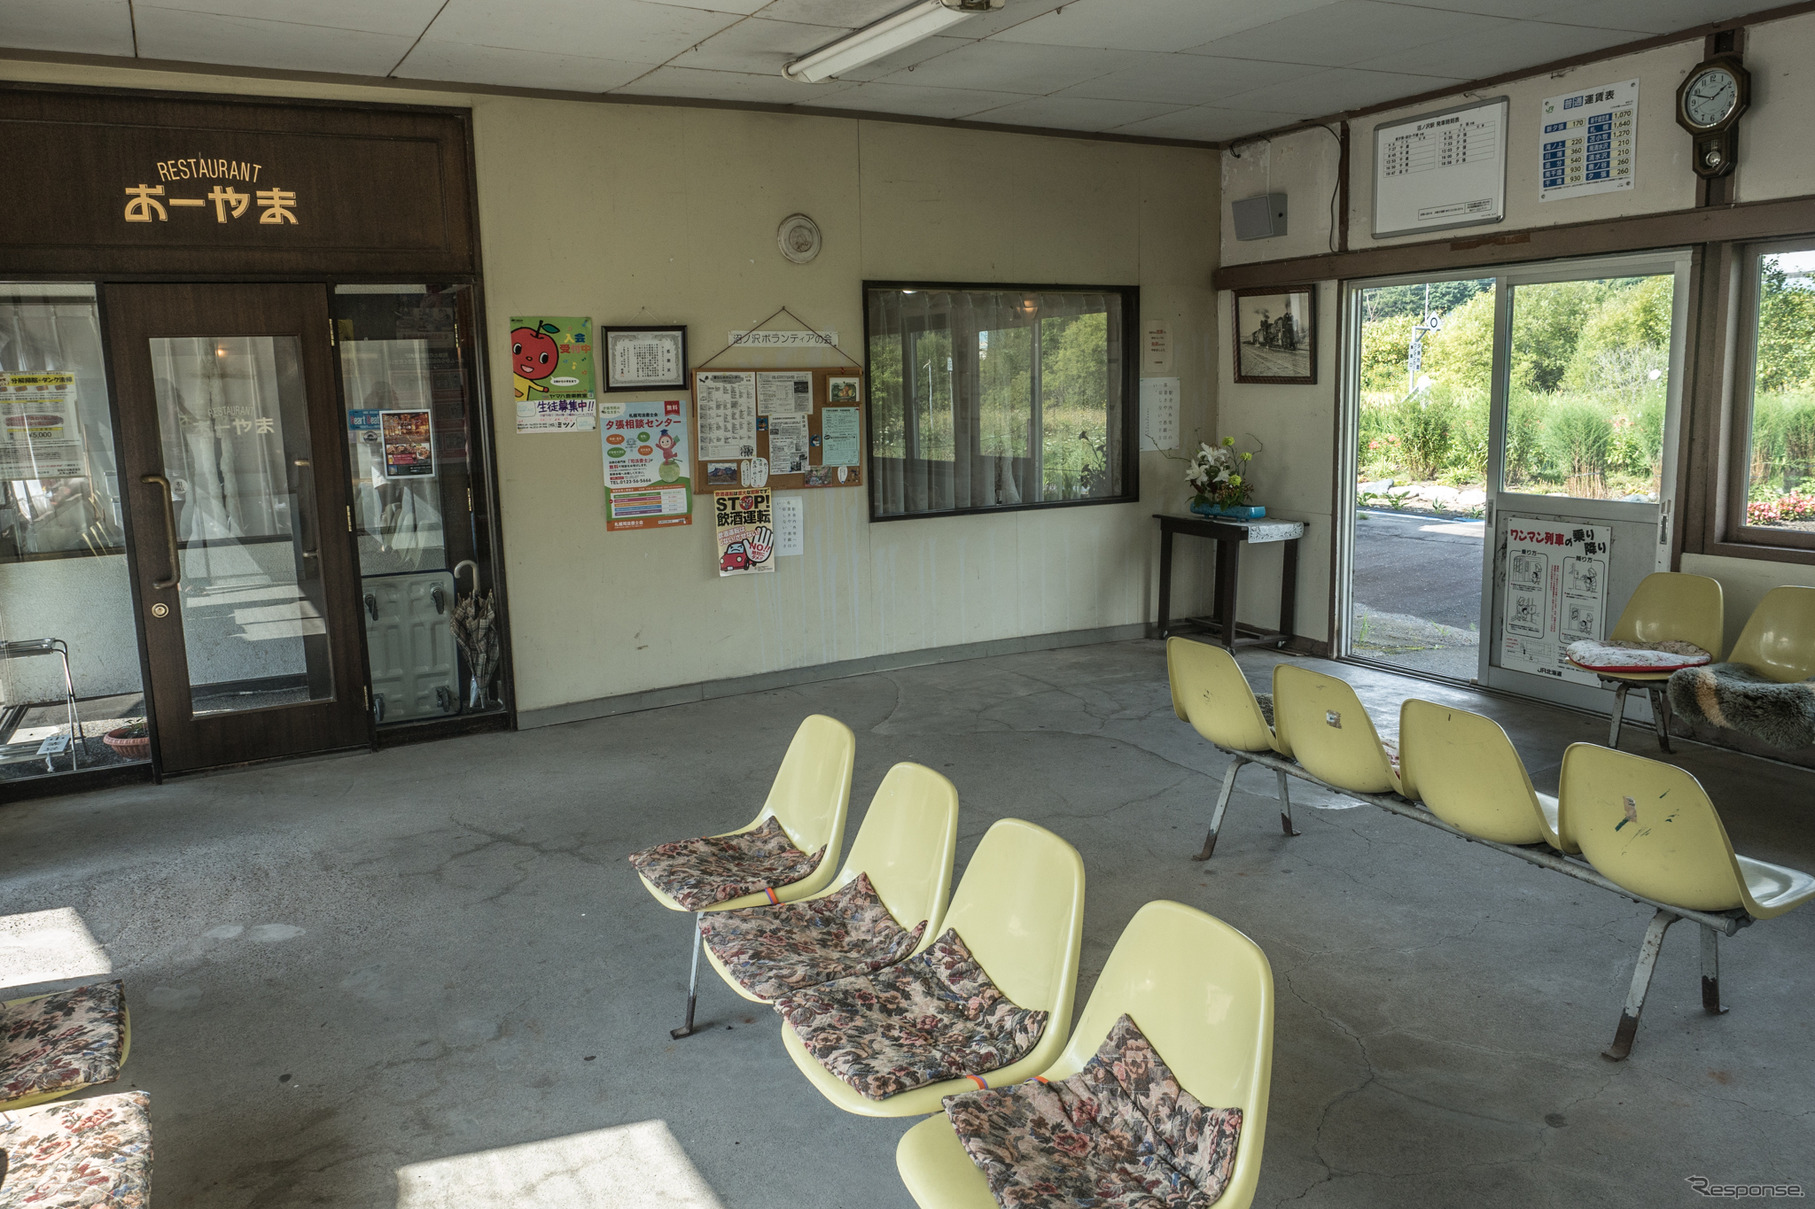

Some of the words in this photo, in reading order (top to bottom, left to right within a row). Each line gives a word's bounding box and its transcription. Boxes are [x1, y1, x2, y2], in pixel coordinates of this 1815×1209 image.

[1614, 110, 1631, 120] 1,070
[1614, 120, 1630, 128] 1,640
[1589, 134, 1608, 142] 苫小牧
[1613, 130, 1630, 138] 1,270
[1588, 152, 1608, 161] 清水沢
[157, 158, 262, 183] RESTAURANT
[124, 184, 299, 224] おーやま
[564, 333, 586, 343] 入会
[734, 334, 832, 345] 沼ノ沢ボランティアの会
[560, 344, 591, 354] 受付中
[605, 418, 681, 430] 夕張相談センター
[716, 495, 770, 512] STOP!
[717, 510, 770, 526] 飲酒運転
[749, 542, 770, 553] NO!!
[1584, 542, 1607, 556] 降り
[1537, 667, 1562, 677] JR北海道
